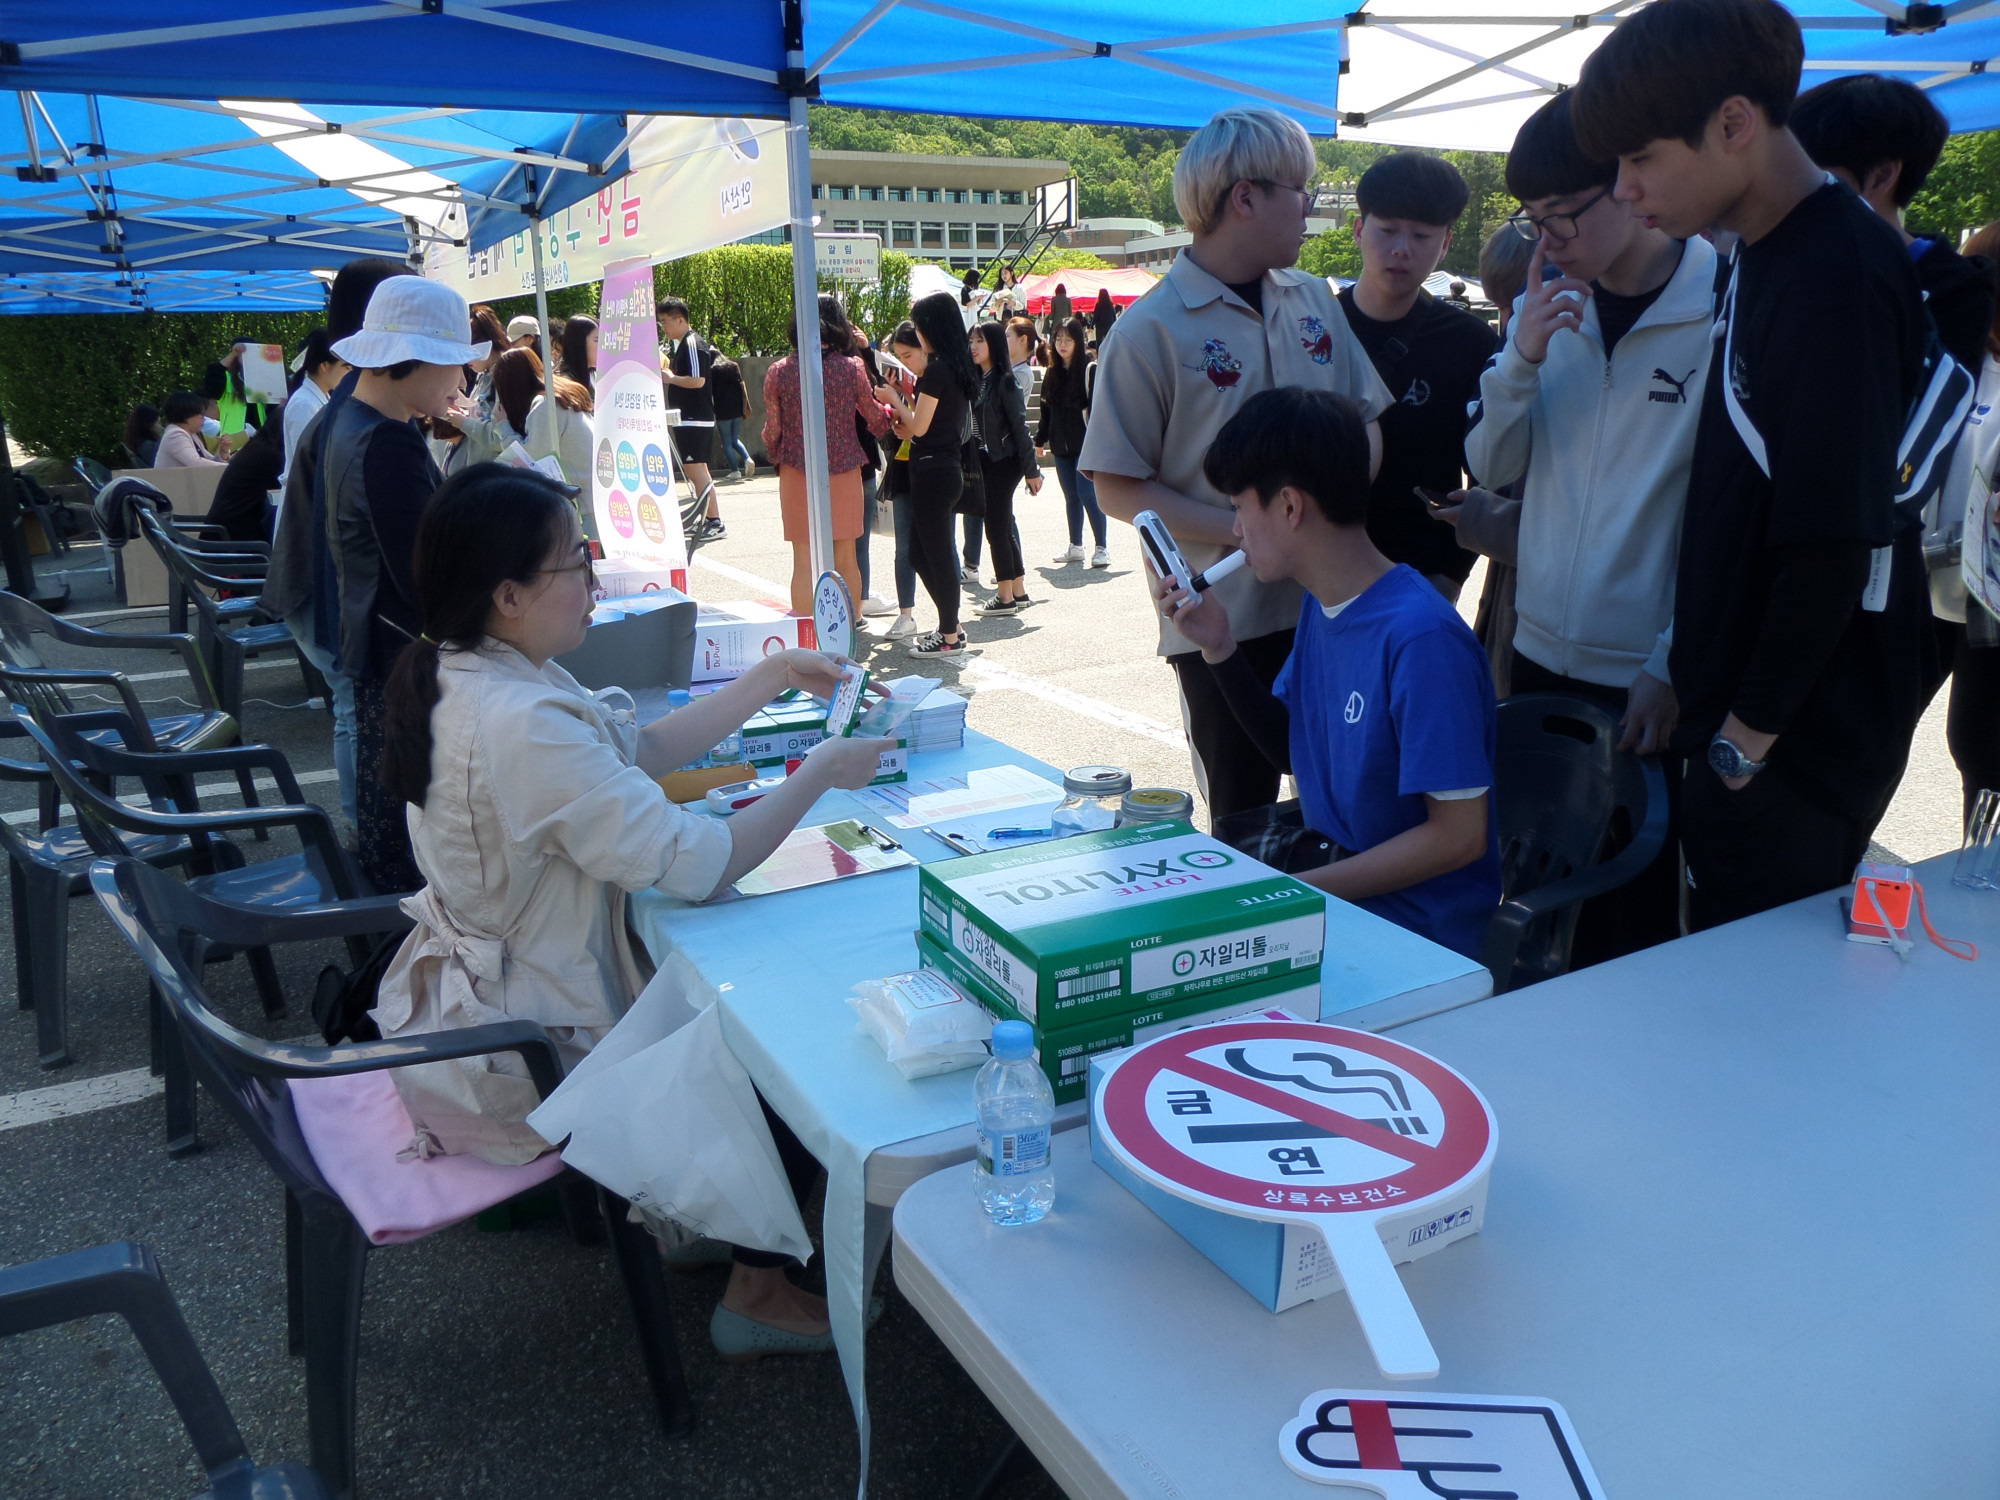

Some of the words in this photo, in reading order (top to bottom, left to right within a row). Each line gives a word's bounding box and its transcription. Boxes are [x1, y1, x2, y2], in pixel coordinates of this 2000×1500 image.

[1649, 391, 1679, 403] PUMA
[800, 736, 822, 748] 자일리
[985, 858, 1186, 905] XYLITOL
[1112, 874, 1202, 896] LOTTE
[951, 896, 968, 913] LOTTE
[1236, 887, 1303, 907] LOTTE
[1130, 936, 1162, 949] LOTTE
[1199, 935, 1267, 967] 자일리톨
[975, 936, 1011, 985] 자일리톨
[952, 967, 969, 985] LOTTE
[1055, 1001, 1060, 1010] 6
[1063, 998, 1076, 1008] 880
[1077, 994, 1094, 1005] 1062
[1095, 989, 1121, 1001] 318492
[1133, 1012, 1164, 1026] LOTTE
[1262, 1183, 1407, 1207] 상록수보건소
